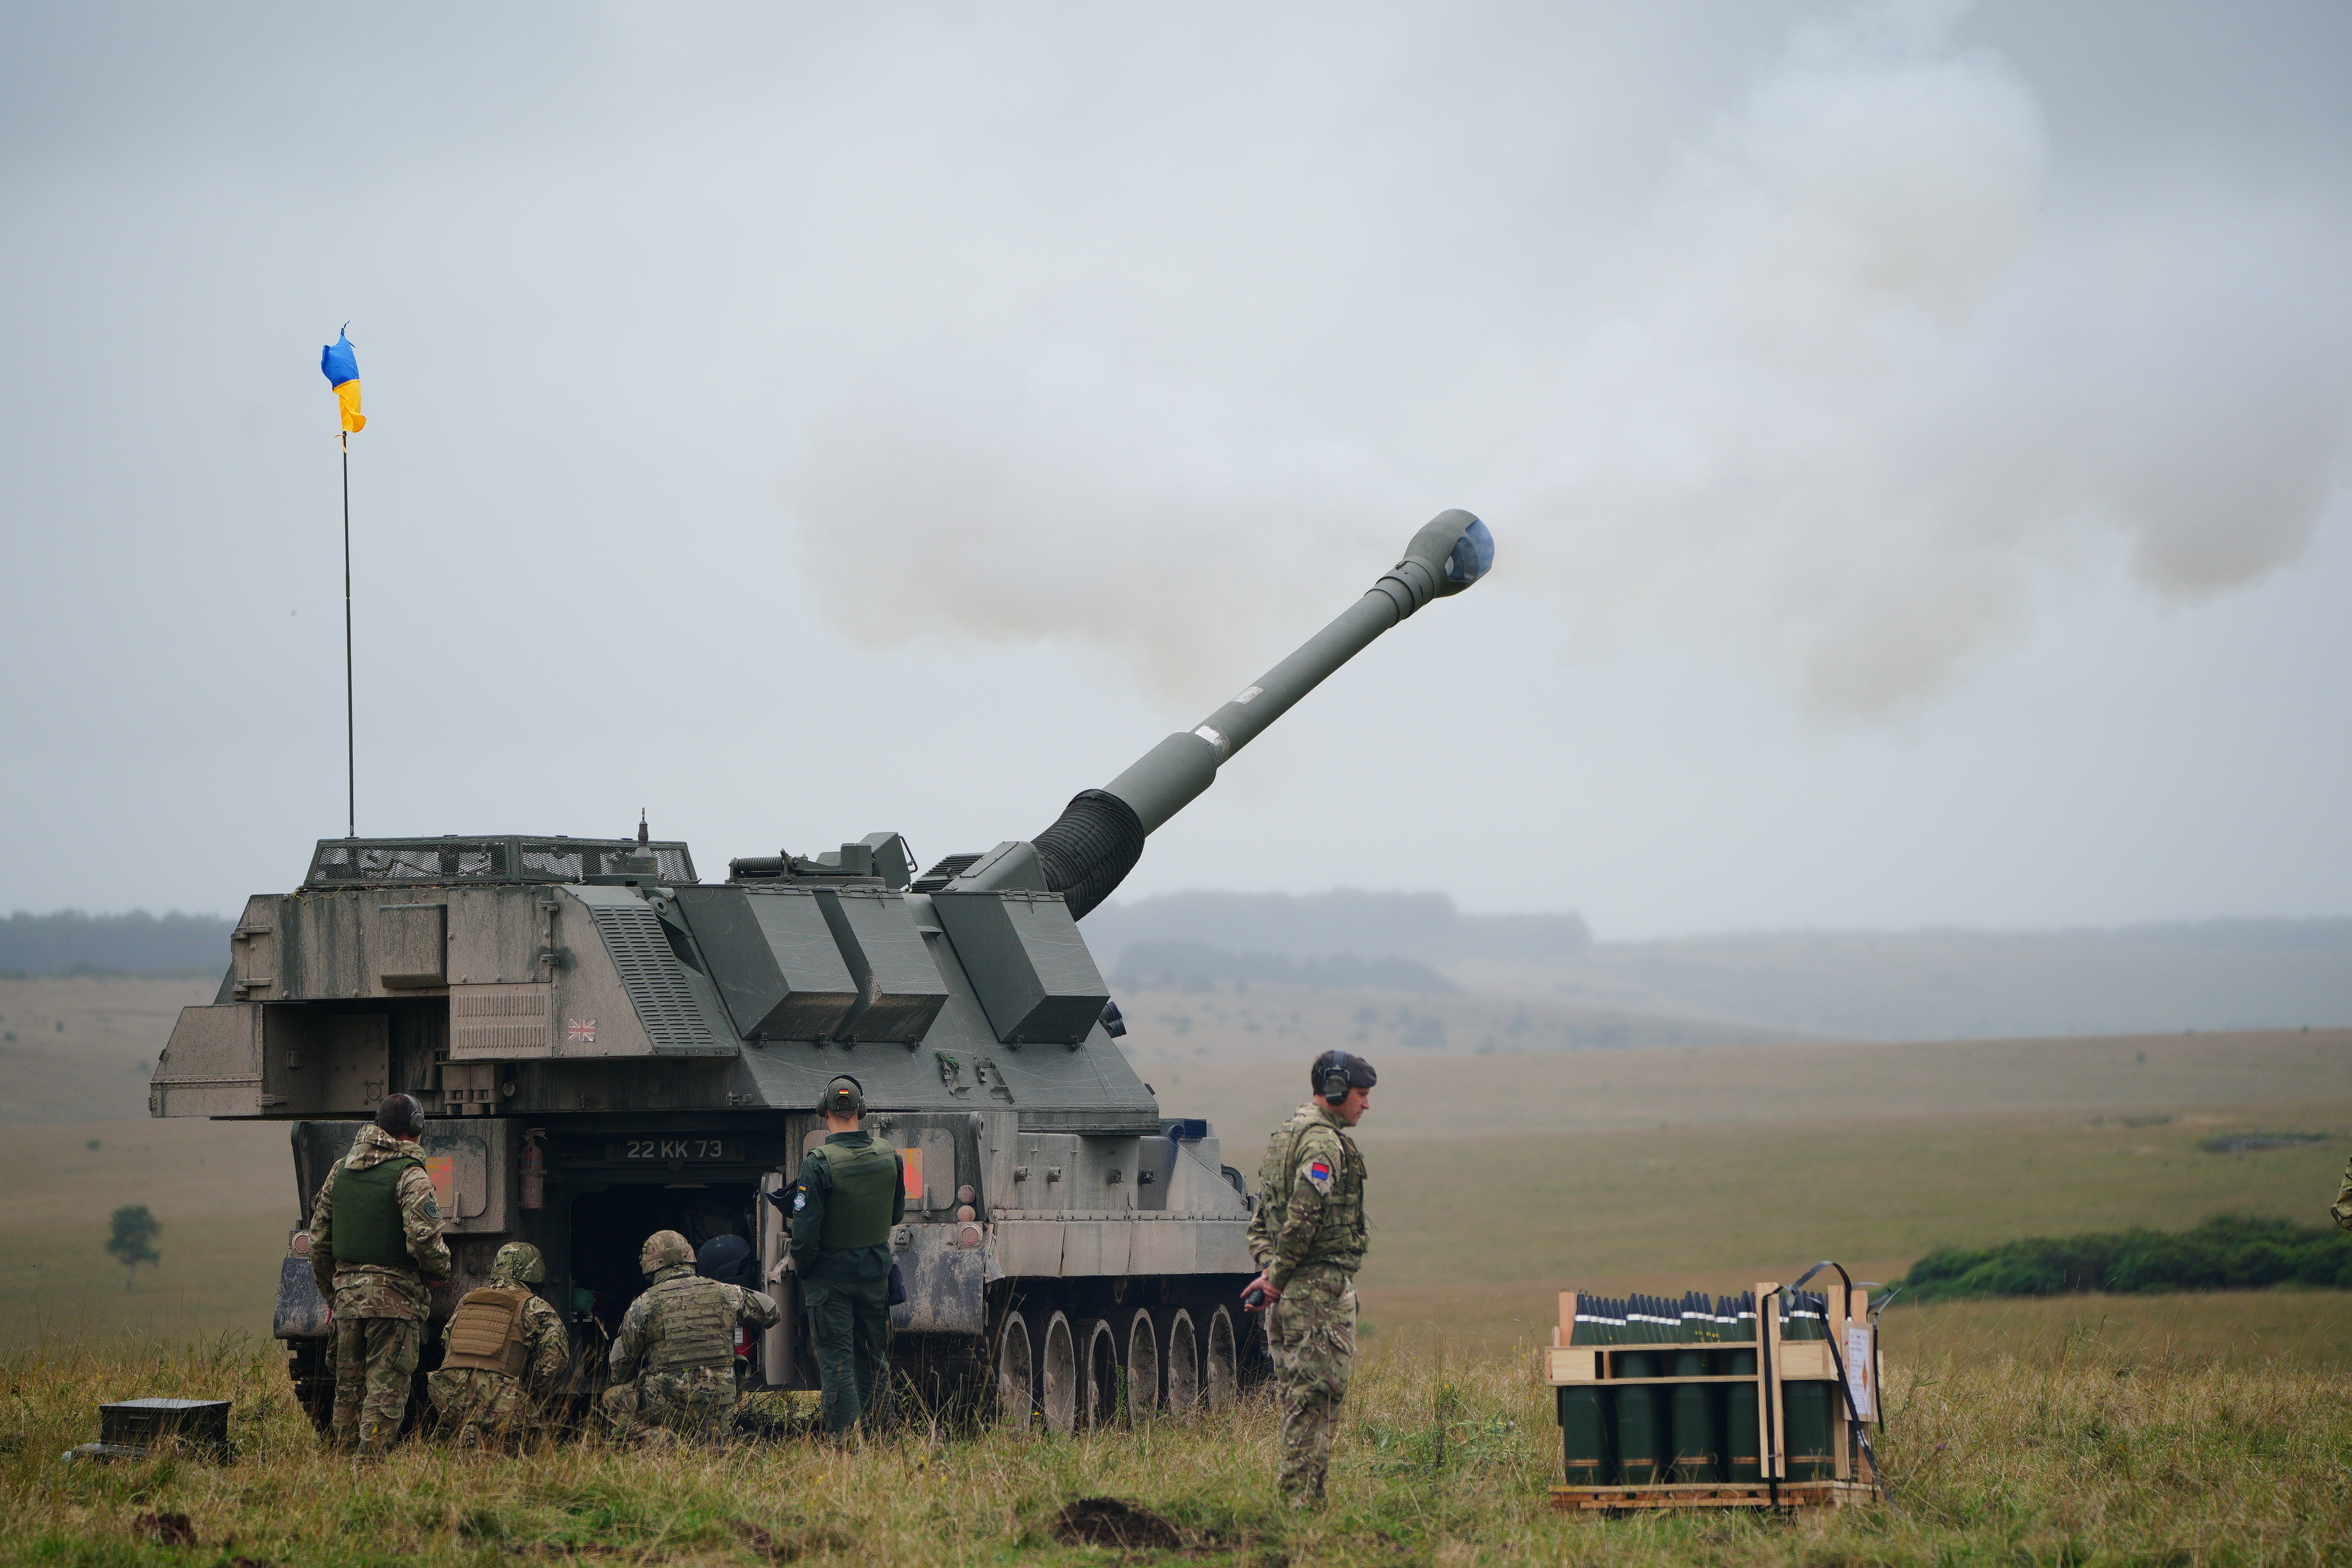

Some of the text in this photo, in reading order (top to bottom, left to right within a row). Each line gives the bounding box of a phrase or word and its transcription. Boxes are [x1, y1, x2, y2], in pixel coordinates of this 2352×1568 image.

[628, 1140, 722, 1158] 22 KK 73
